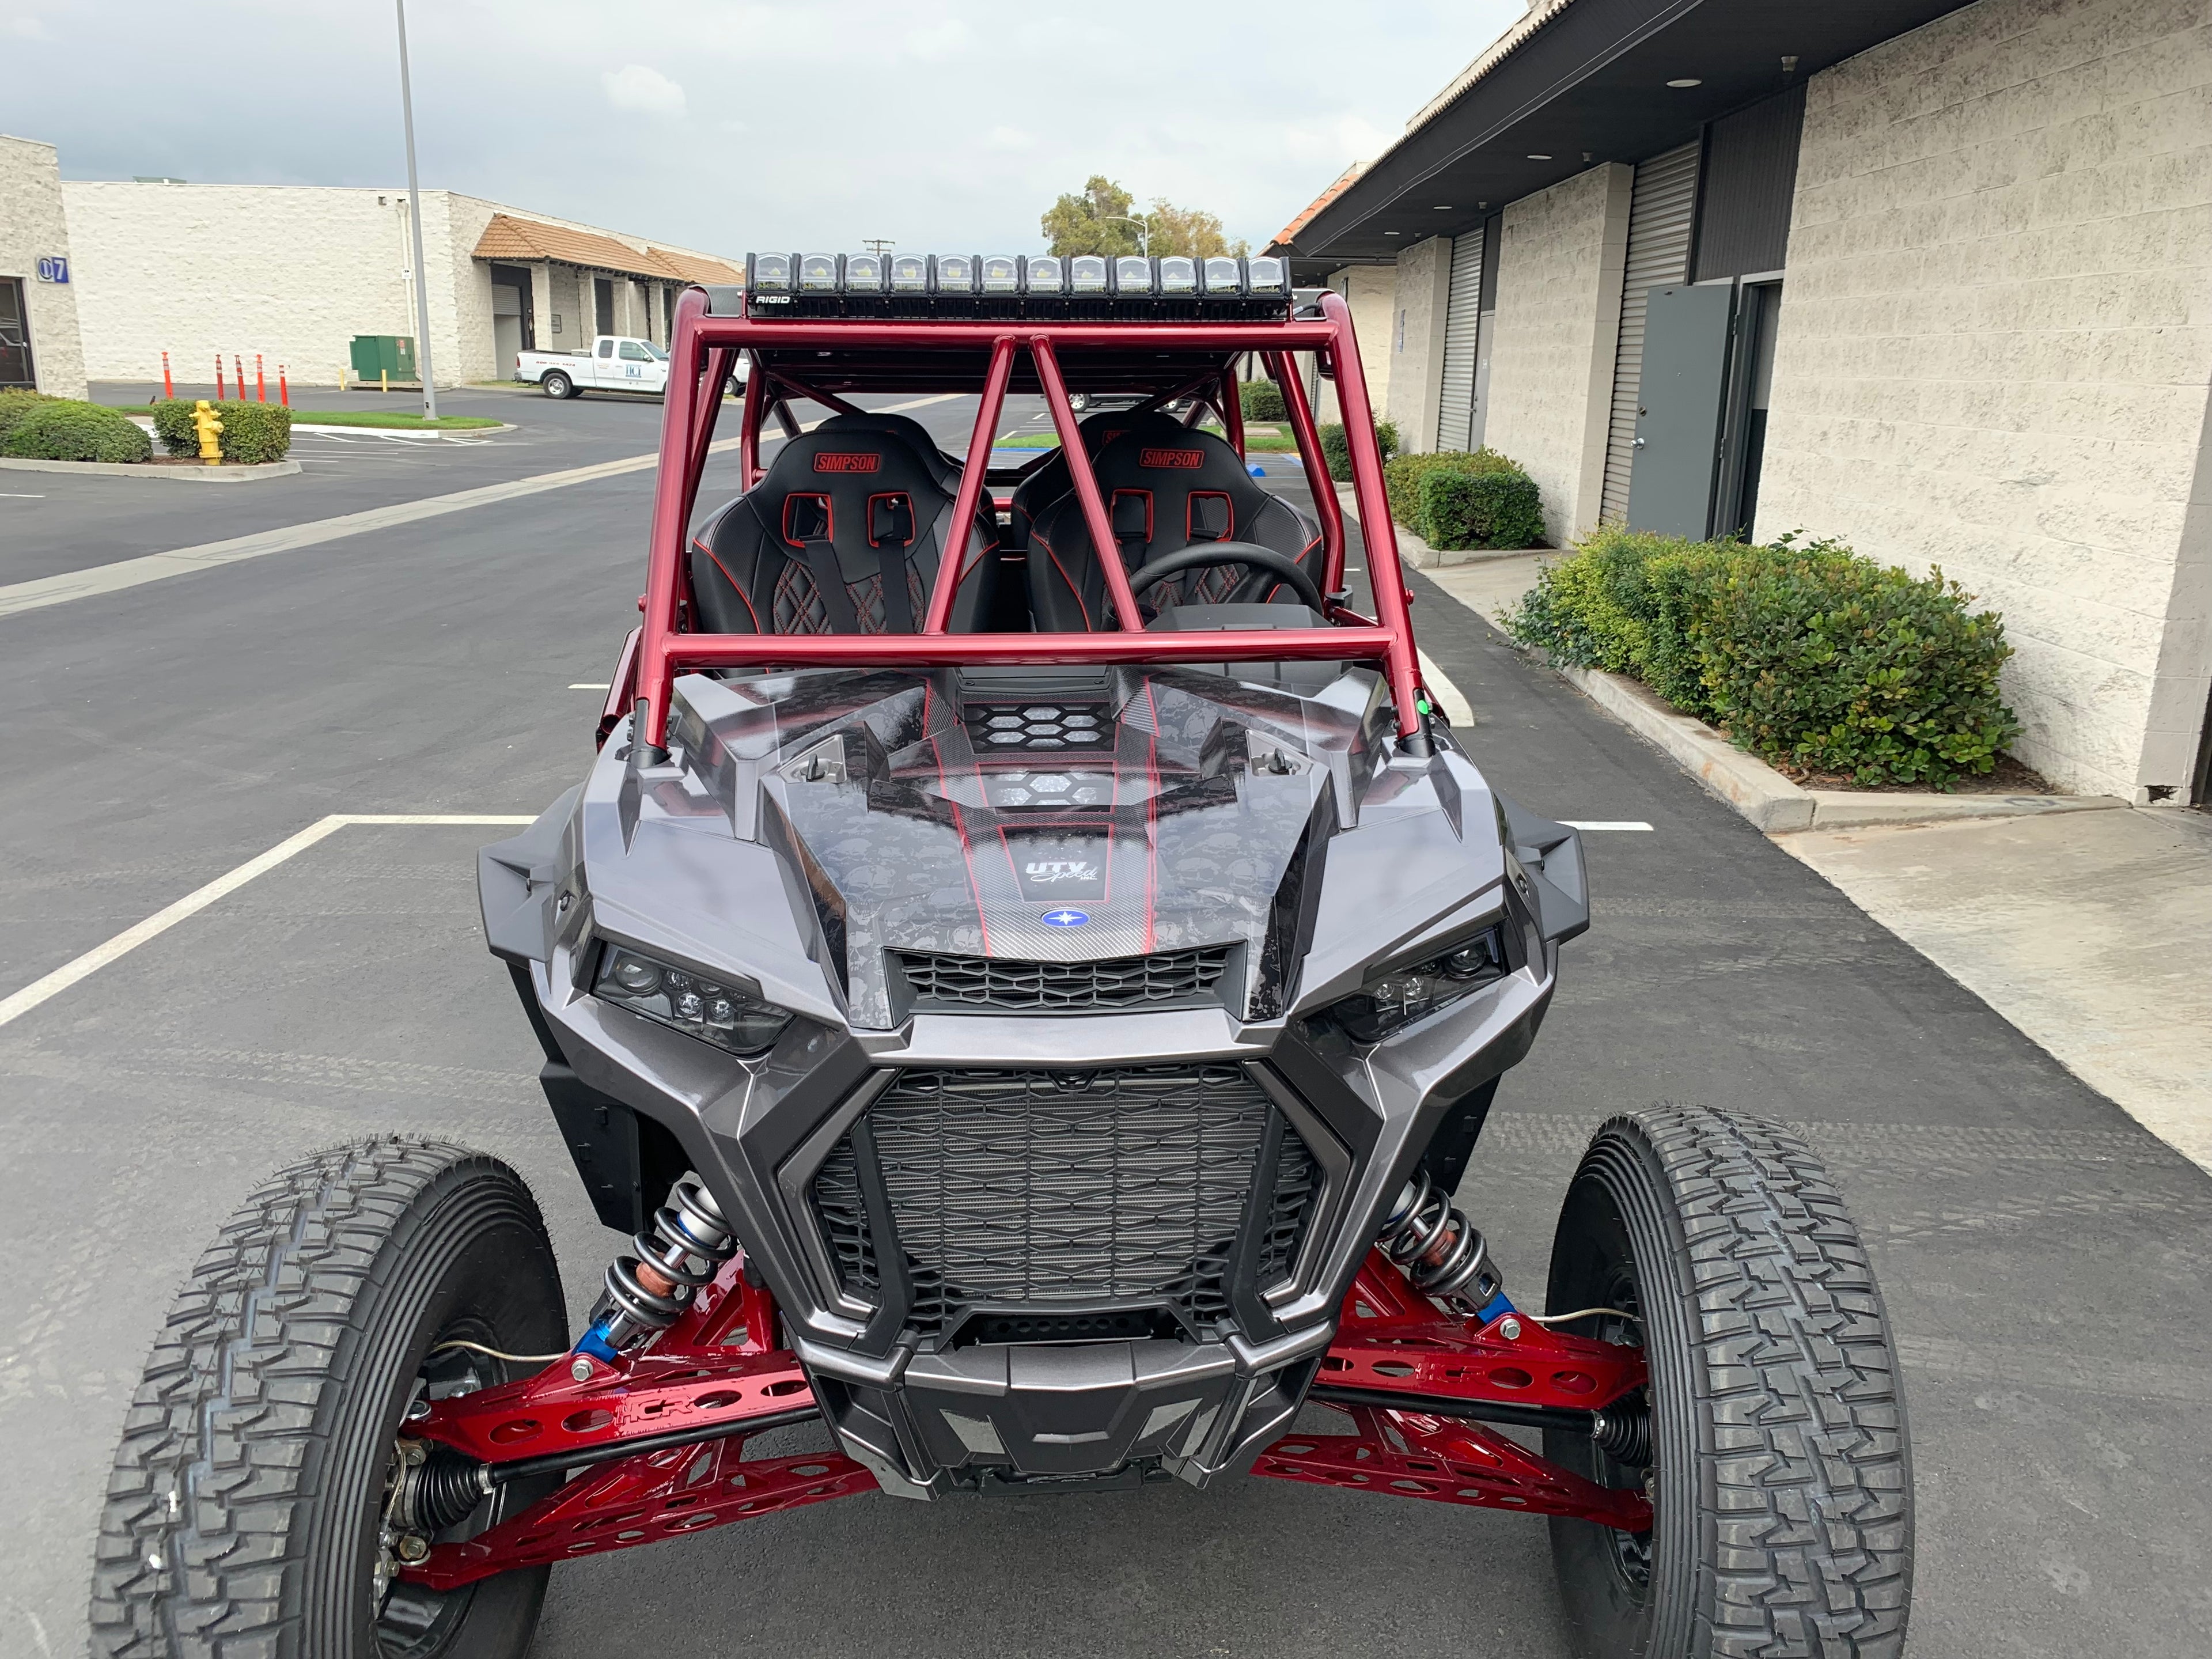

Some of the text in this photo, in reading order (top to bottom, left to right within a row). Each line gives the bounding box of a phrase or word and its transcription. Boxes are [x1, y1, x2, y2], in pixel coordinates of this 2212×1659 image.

[756, 296, 790, 304] RIGID
[818, 456, 876, 470] SIMPSON
[1143, 451, 1200, 467] SIMPSON
[1025, 862, 1088, 874] UTV
[1030, 866, 1099, 882] Speed
[615, 1394, 693, 1426] HCR
